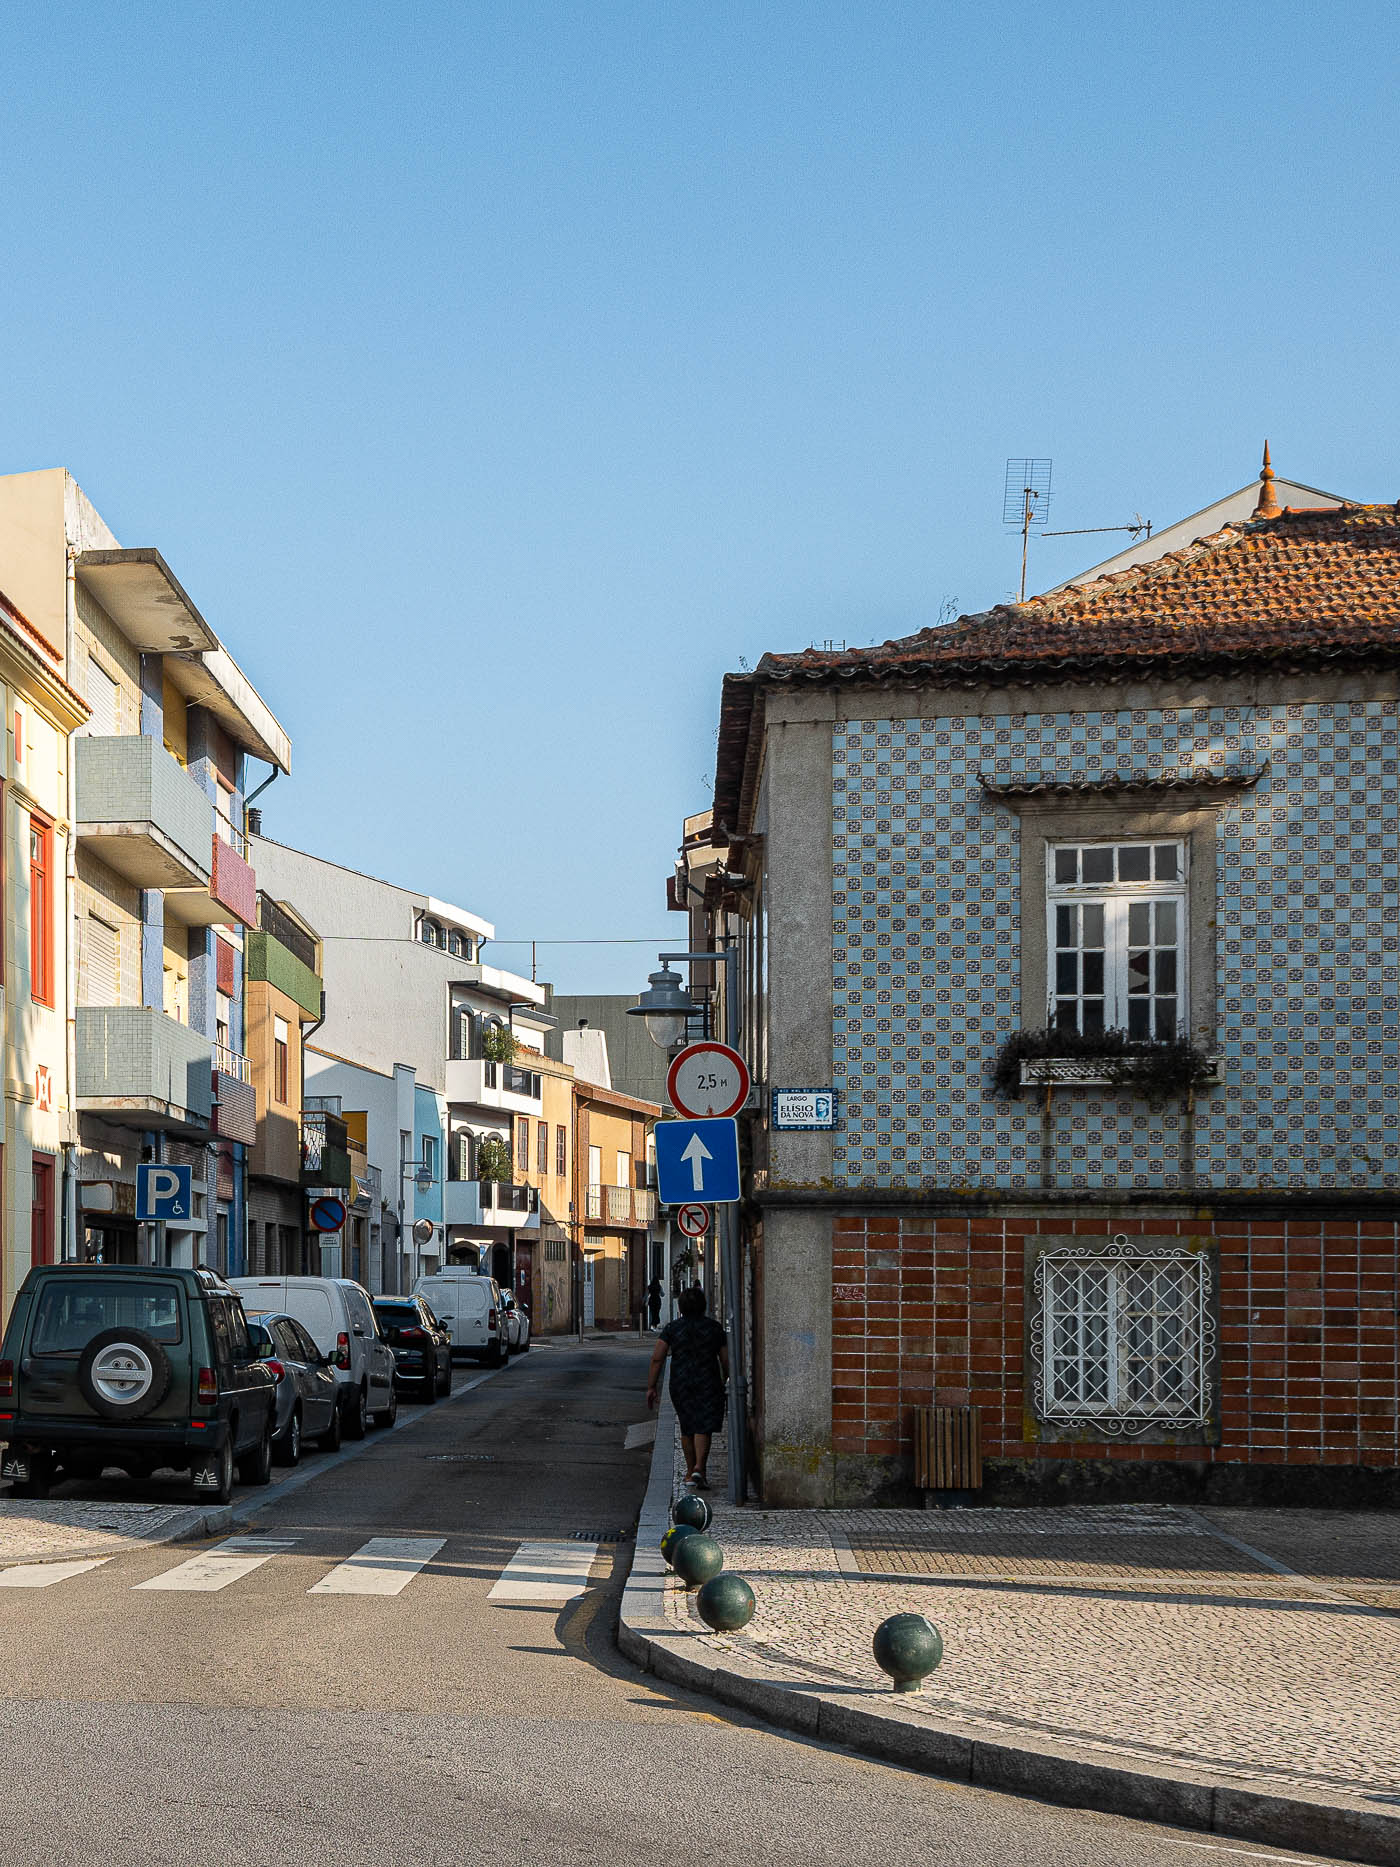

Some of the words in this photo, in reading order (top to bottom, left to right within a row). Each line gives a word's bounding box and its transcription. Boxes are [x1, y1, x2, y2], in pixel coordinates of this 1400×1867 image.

[697, 1073, 717, 1091] 2,5
[780, 1103, 814, 1112] ELÍSIO
[780, 1111, 791, 1119] DA
[792, 1111, 814, 1119] NOVA
[147, 1168, 180, 1215] P
